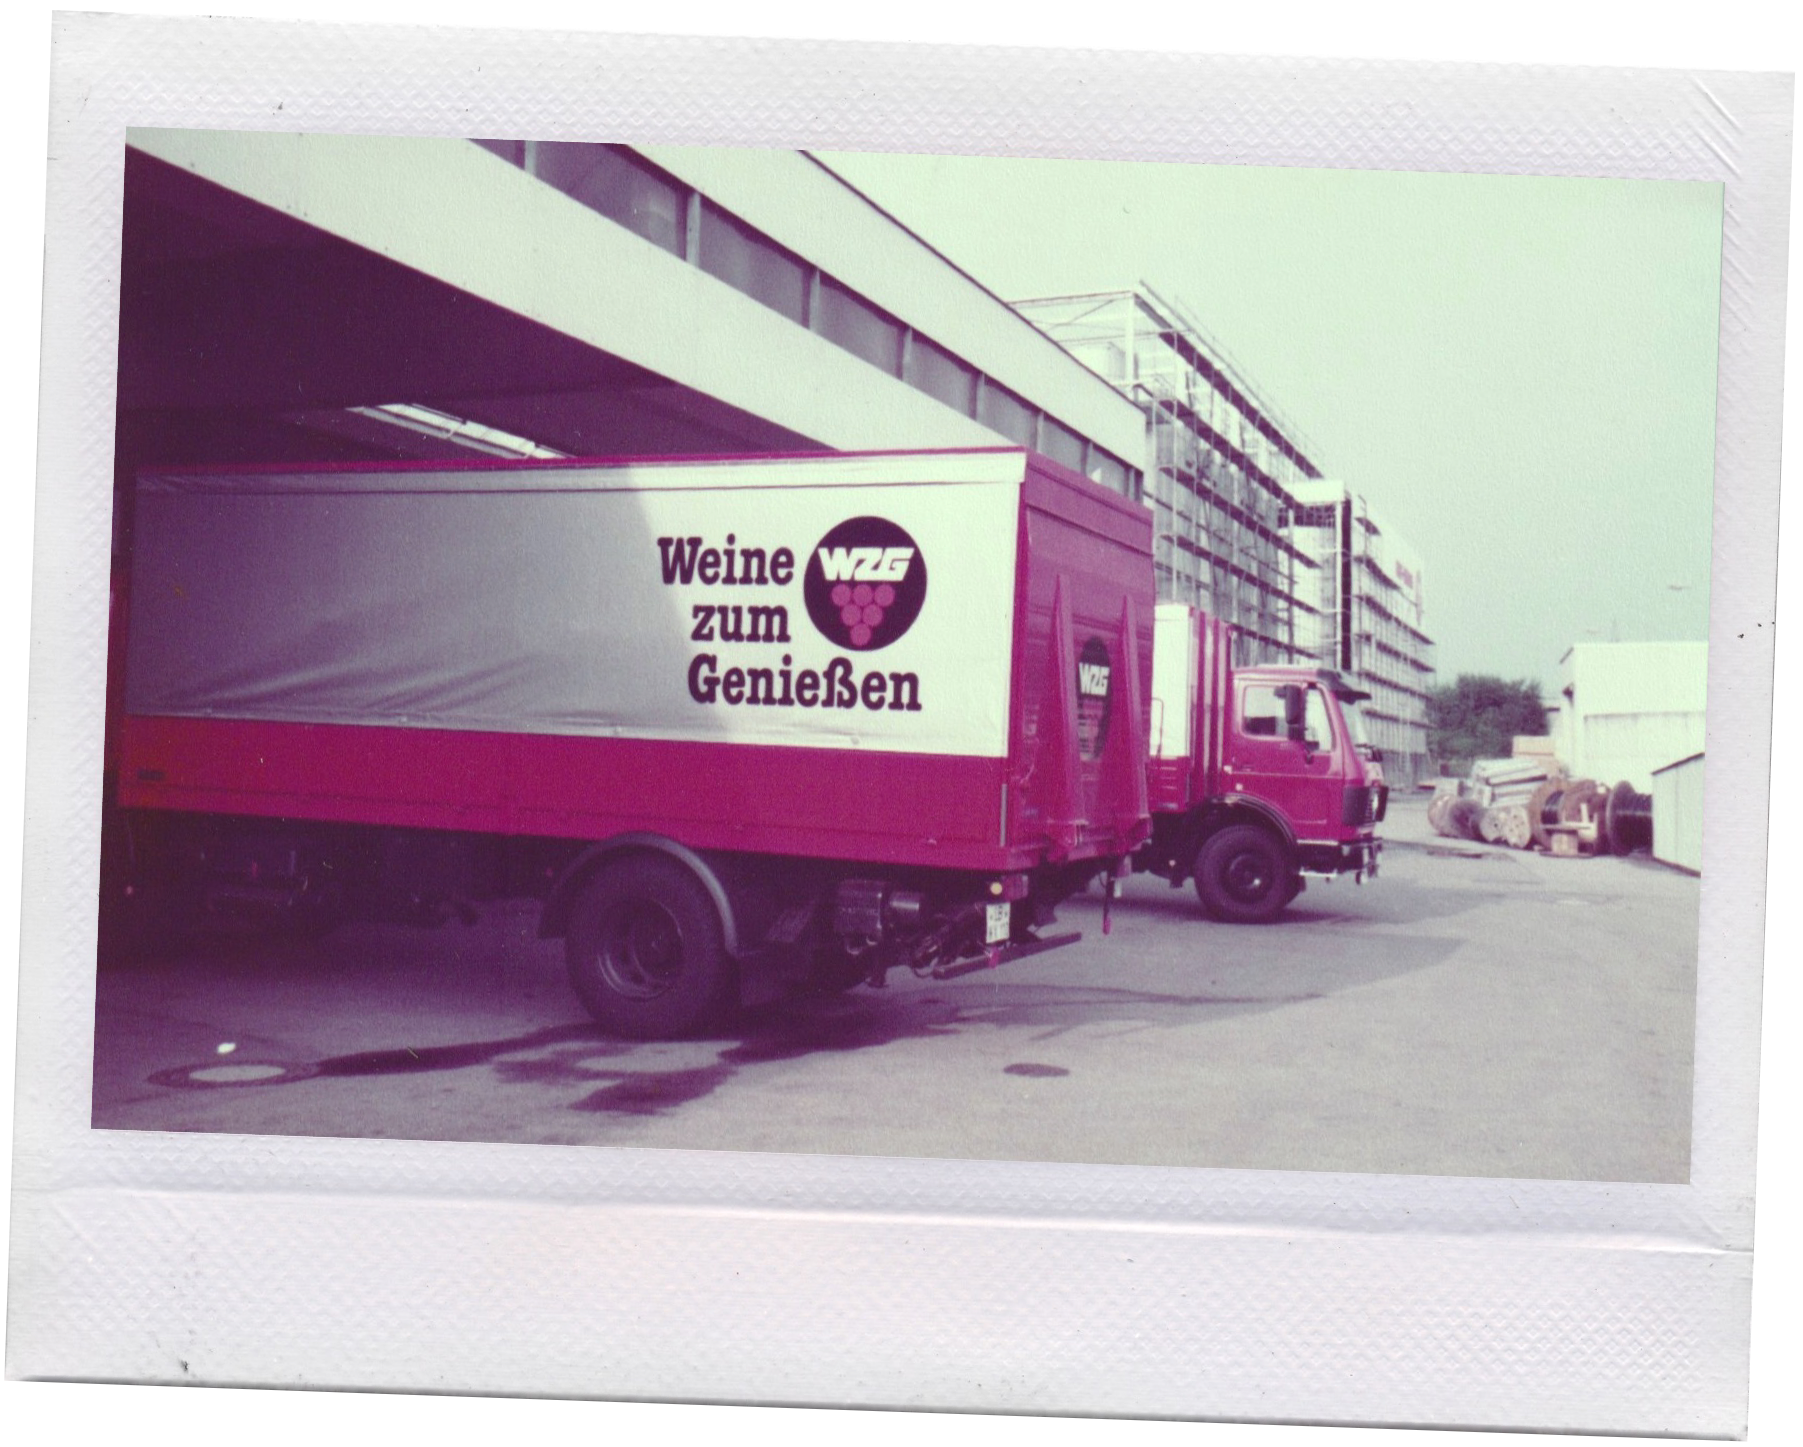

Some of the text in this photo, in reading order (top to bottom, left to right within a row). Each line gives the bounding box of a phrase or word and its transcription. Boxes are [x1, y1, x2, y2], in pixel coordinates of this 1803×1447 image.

[657, 533, 795, 585] Weine
[817, 547, 915, 581] WZG
[691, 604, 791, 643] zum
[687, 653, 922, 711] Genießen
[1079, 661, 1110, 696] WZG
